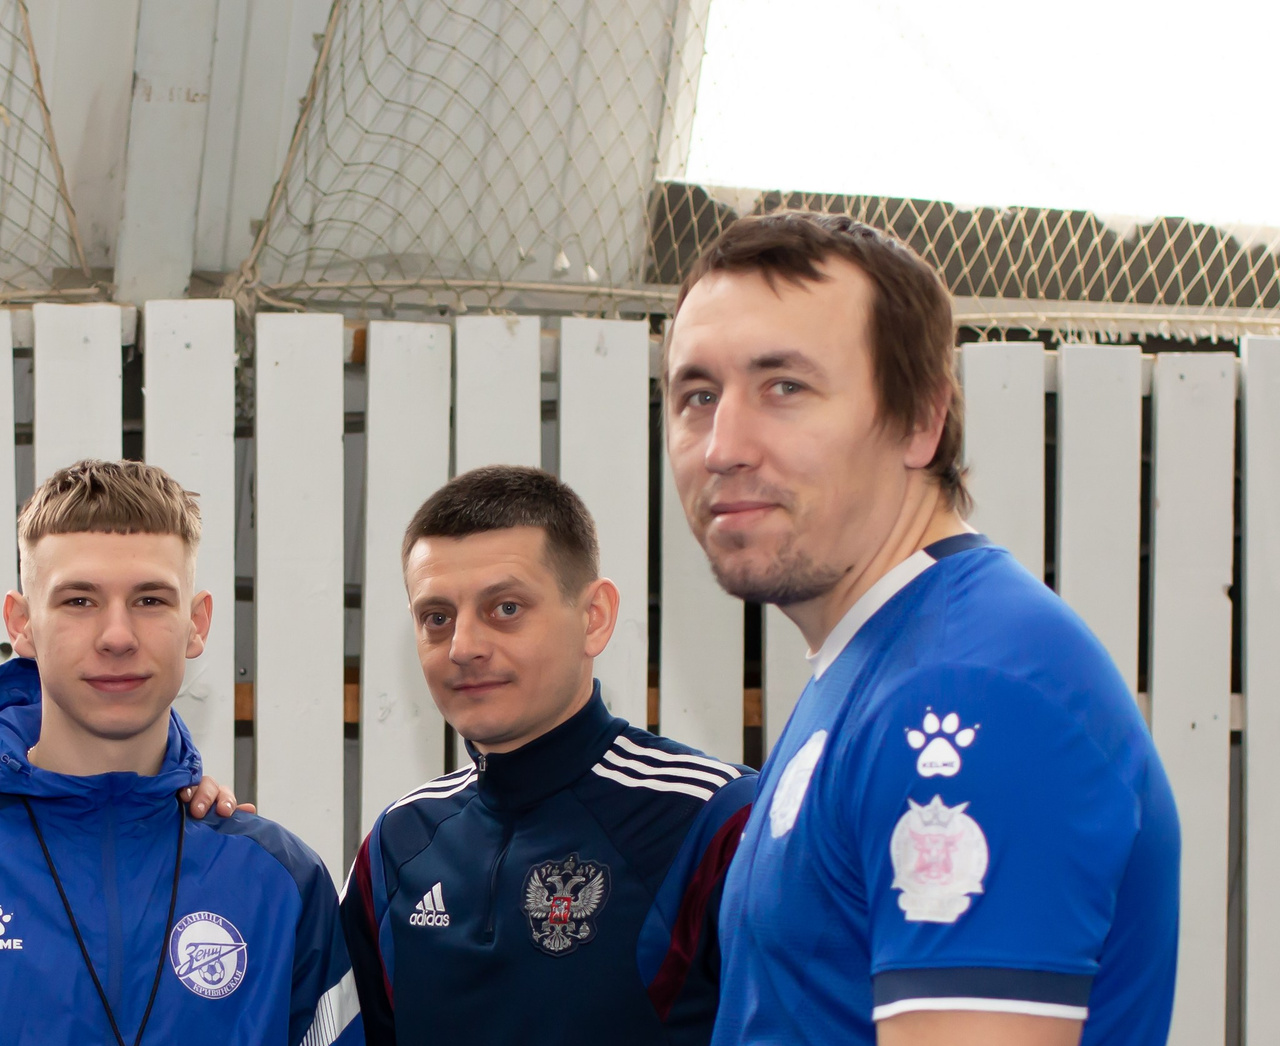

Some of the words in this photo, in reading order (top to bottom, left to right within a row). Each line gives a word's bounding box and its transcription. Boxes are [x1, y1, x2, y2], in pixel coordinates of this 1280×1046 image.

[177, 912, 223, 931] СТАНИЦА
[409, 910, 450, 927] adidas
[193, 969, 243, 996] КРИВЯНСКАЯ
